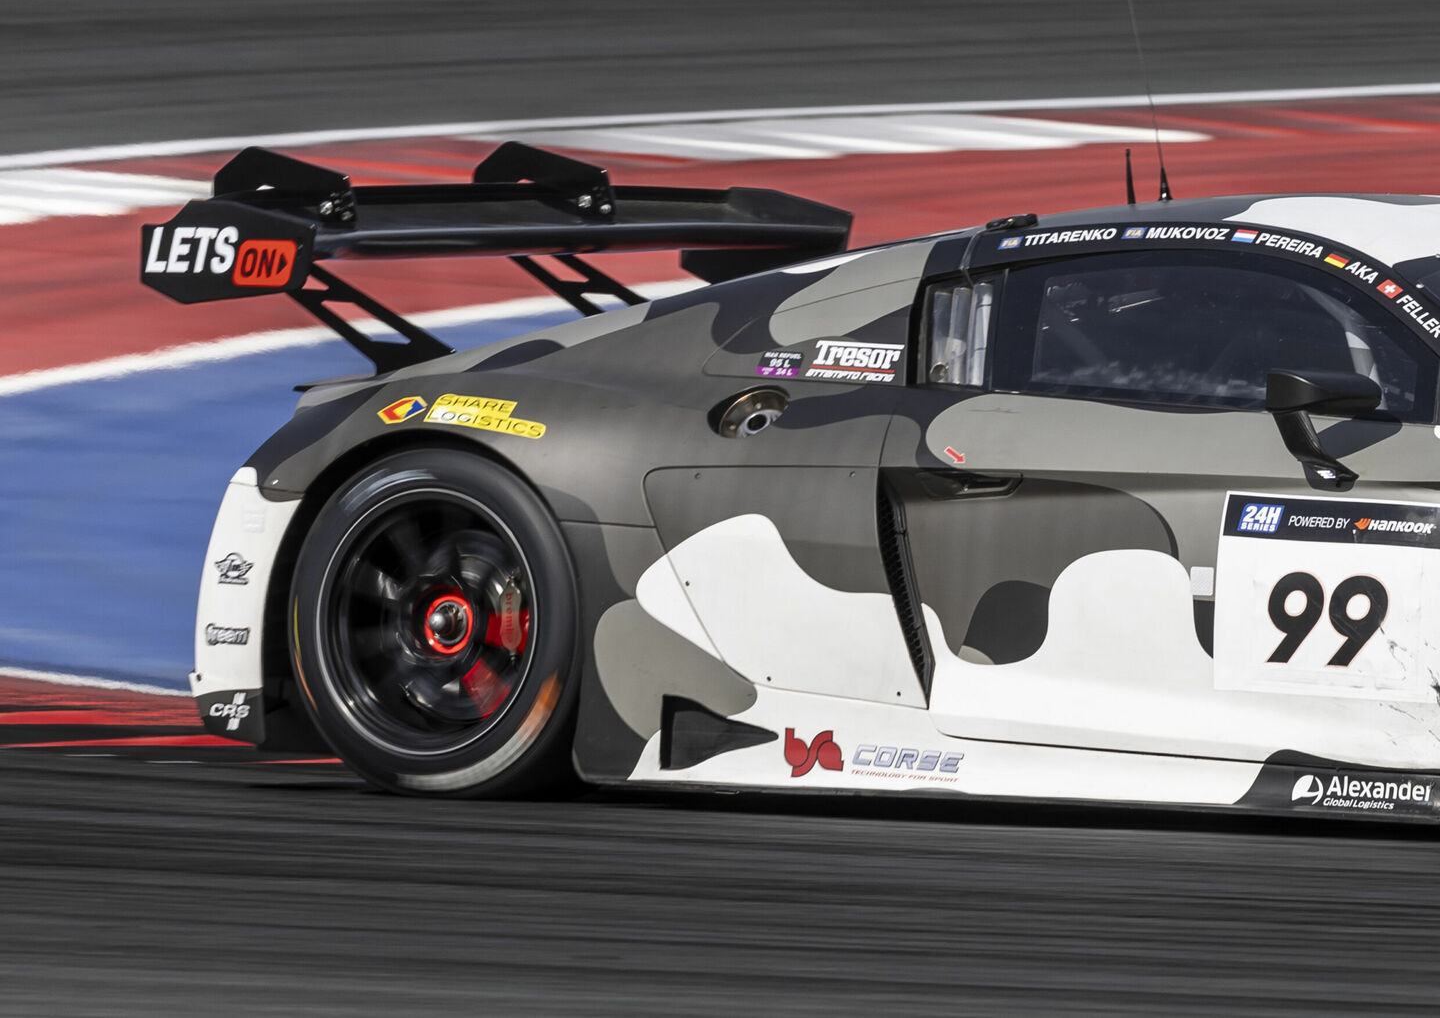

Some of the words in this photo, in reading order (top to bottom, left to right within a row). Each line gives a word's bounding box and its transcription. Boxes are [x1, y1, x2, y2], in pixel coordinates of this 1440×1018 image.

[145, 226, 239, 274] LETS
[241, 248, 277, 278] ON
[1001, 239, 1020, 248] FIA
[1024, 228, 1117, 246] TITARENKO
[1125, 229, 1143, 238] FIA
[1145, 227, 1230, 241] MUKOVOZ
[1255, 232, 1324, 259] PEREIRA
[1345, 261, 1380, 284] AKA
[812, 340, 905, 369] Tresor
[436, 395, 512, 414] SHARE
[427, 409, 543, 438] LOGISTICS
[1240, 522, 1276, 532] SERIES
[1242, 505, 1283, 524] 24H
[1288, 515, 1335, 528] POWERED
[1335, 518, 1351, 529] BY
[1265, 571, 1389, 667] 99
[852, 744, 965, 774] CORSE
[1326, 775, 1431, 802] Alexander
[1323, 797, 1352, 807] Global
[1352, 799, 1395, 810] Logistics
